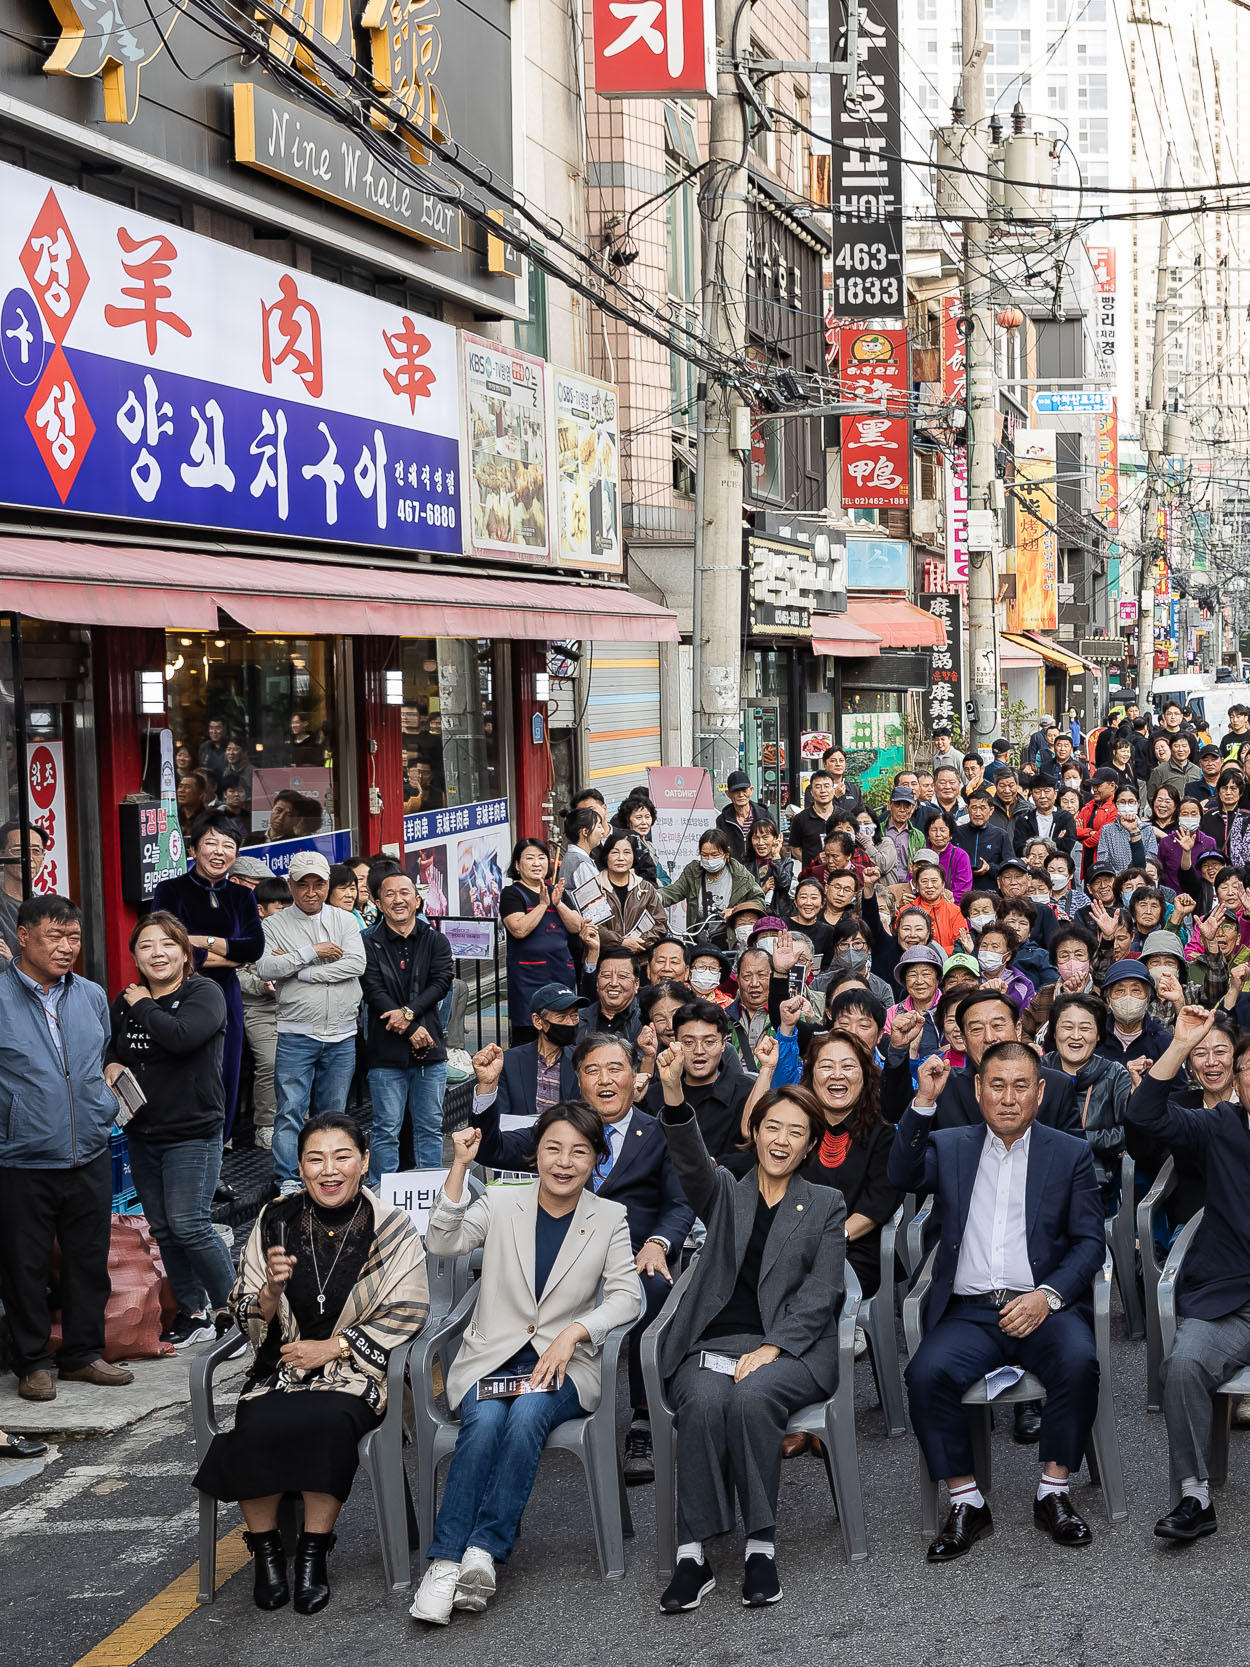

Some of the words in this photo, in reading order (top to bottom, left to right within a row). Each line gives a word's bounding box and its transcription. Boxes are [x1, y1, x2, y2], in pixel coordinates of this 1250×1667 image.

[268, 107, 332, 181] Nine
[341, 141, 413, 217] Whale
[421, 192, 456, 236] Bar
[840, 194, 894, 224] HOF
[836, 276, 898, 304] 1833
[5, 307, 34, 364] 구
[104, 226, 437, 417] 羊肉串
[469, 351, 486, 375] KBS
[116, 373, 388, 530] 양꼬치구이
[397, 498, 456, 529] 467-6880
[31, 762, 55, 792] 원조
[436, 808, 470, 835] 京城羊肉串
[143, 842, 161, 865] 오늘
